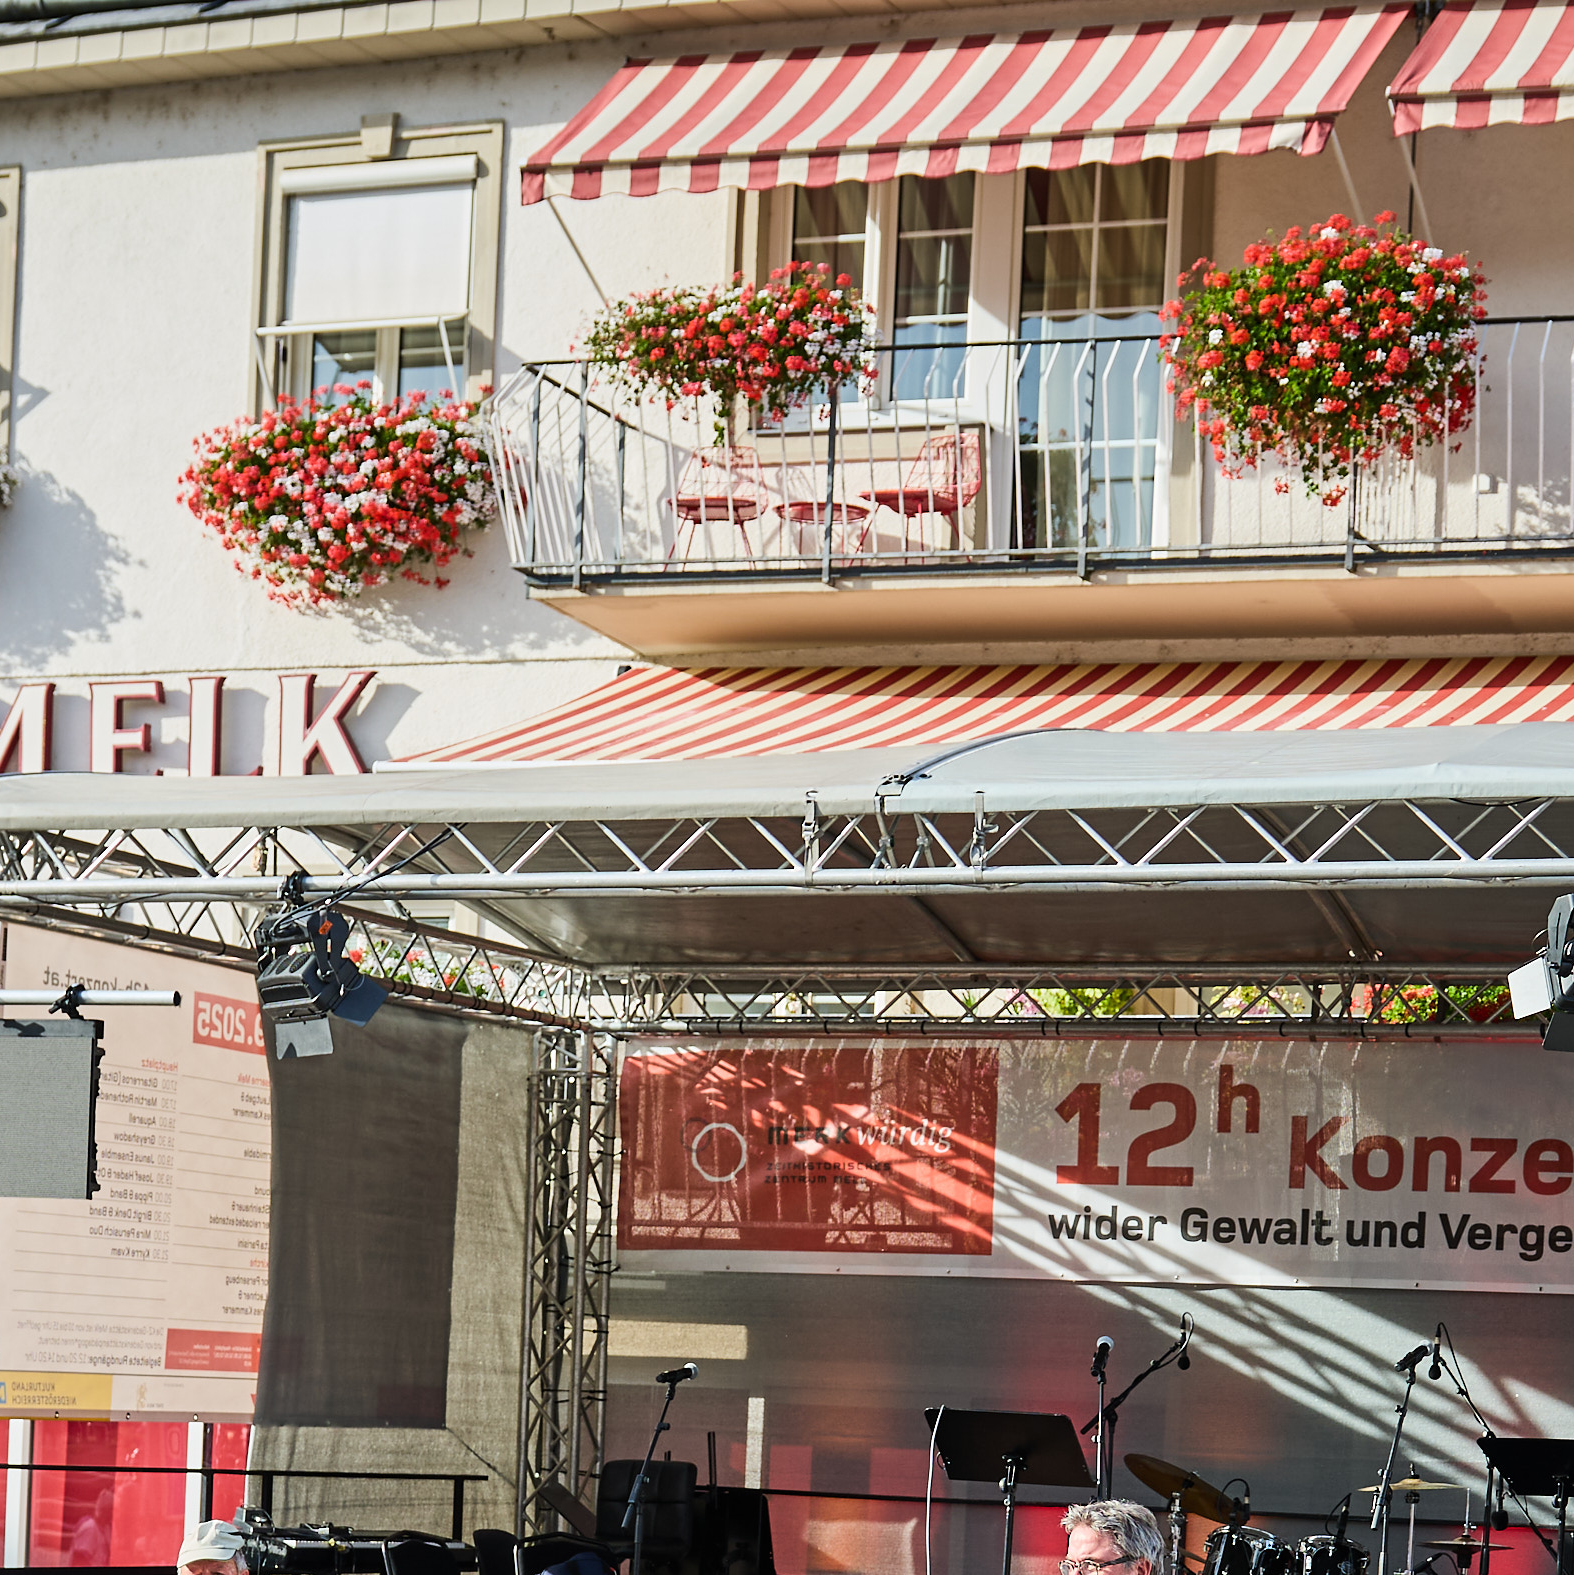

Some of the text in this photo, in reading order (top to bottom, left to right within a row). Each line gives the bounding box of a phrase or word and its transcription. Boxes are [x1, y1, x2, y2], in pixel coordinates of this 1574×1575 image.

[1053, 1063, 1261, 1188] 12h
[1048, 1205, 1168, 1242] wider
[1180, 1207, 1332, 1247] Gewalt
[1346, 1211, 1427, 1249] und
